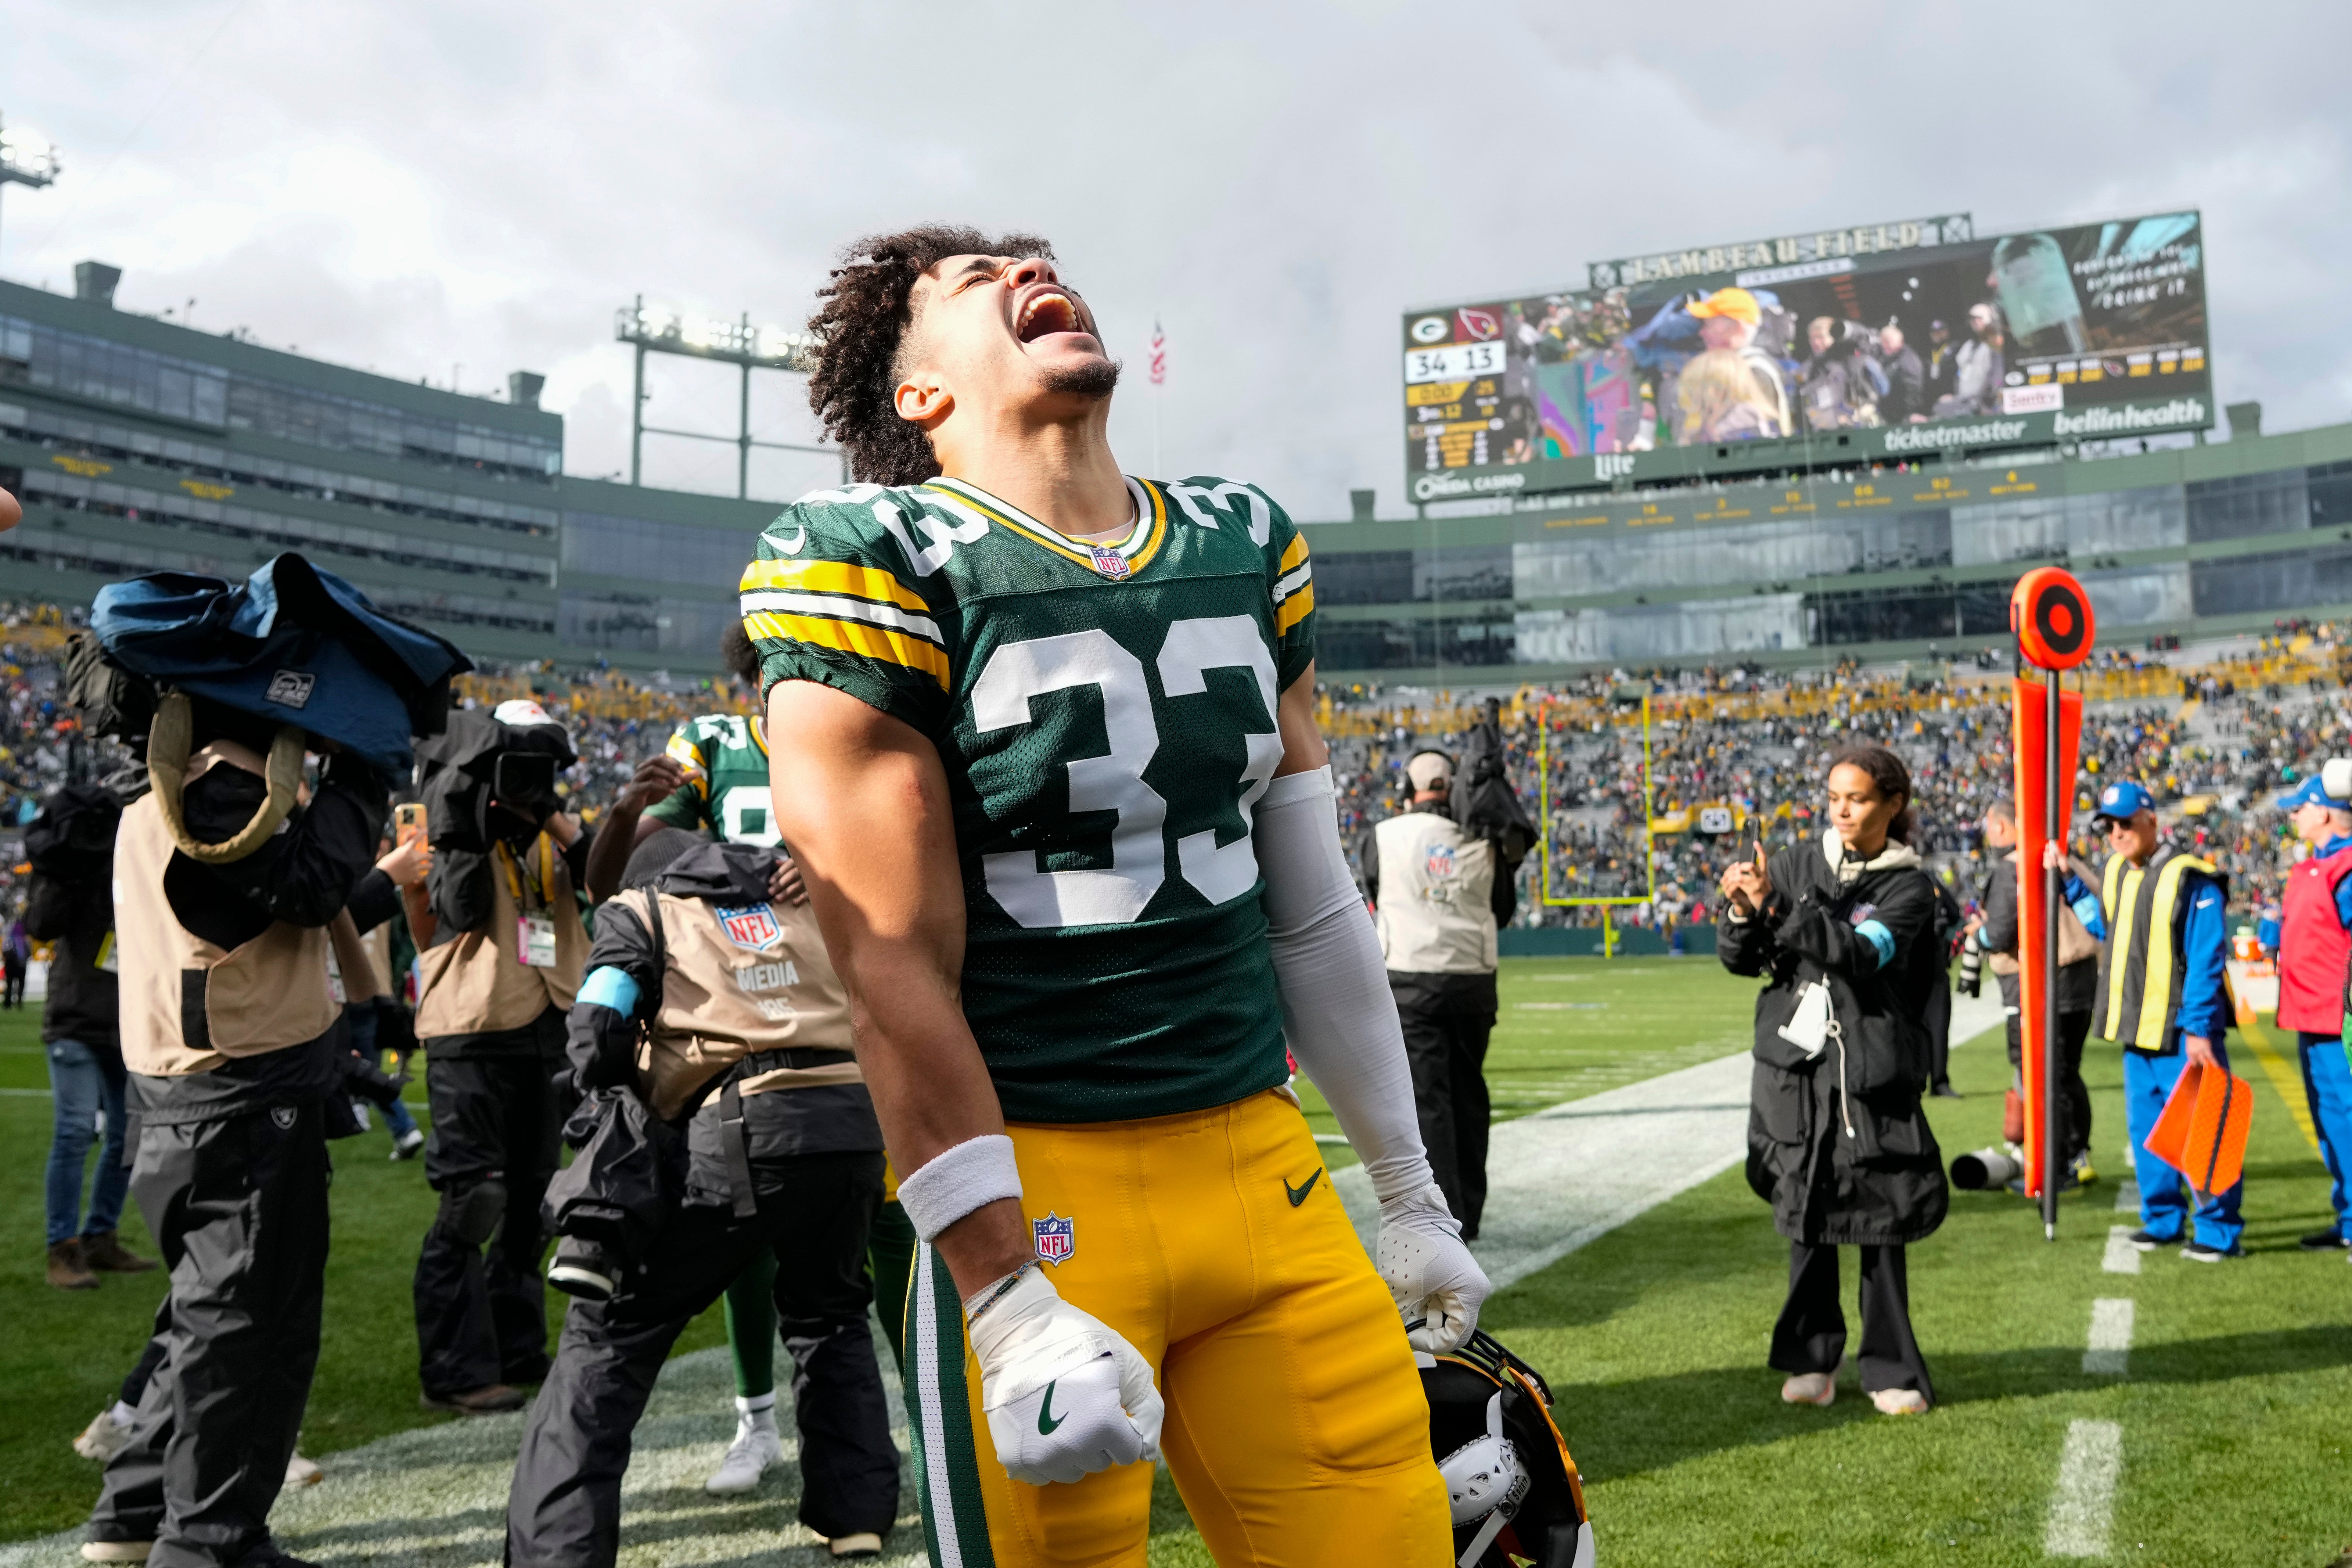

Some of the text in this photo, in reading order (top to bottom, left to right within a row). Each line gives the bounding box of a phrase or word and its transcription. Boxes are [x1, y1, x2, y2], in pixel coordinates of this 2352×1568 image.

[1634, 238, 1798, 282] LAMBEAU
[1815, 224, 1920, 259] FIELD
[1417, 353, 1446, 376] 34
[1464, 348, 1492, 370] 13
[2008, 389, 2057, 407] Sentry
[1884, 419, 2027, 452] ticketmaster
[1594, 453, 1636, 482] Lite
[1472, 472, 1525, 492] CASINO
[1099, 558, 1125, 572] NFL
[971, 614, 1285, 929] 33
[727, 915, 774, 944] NFL
[736, 960, 801, 992] MEDIA
[1040, 1236, 1069, 1256] NFL
